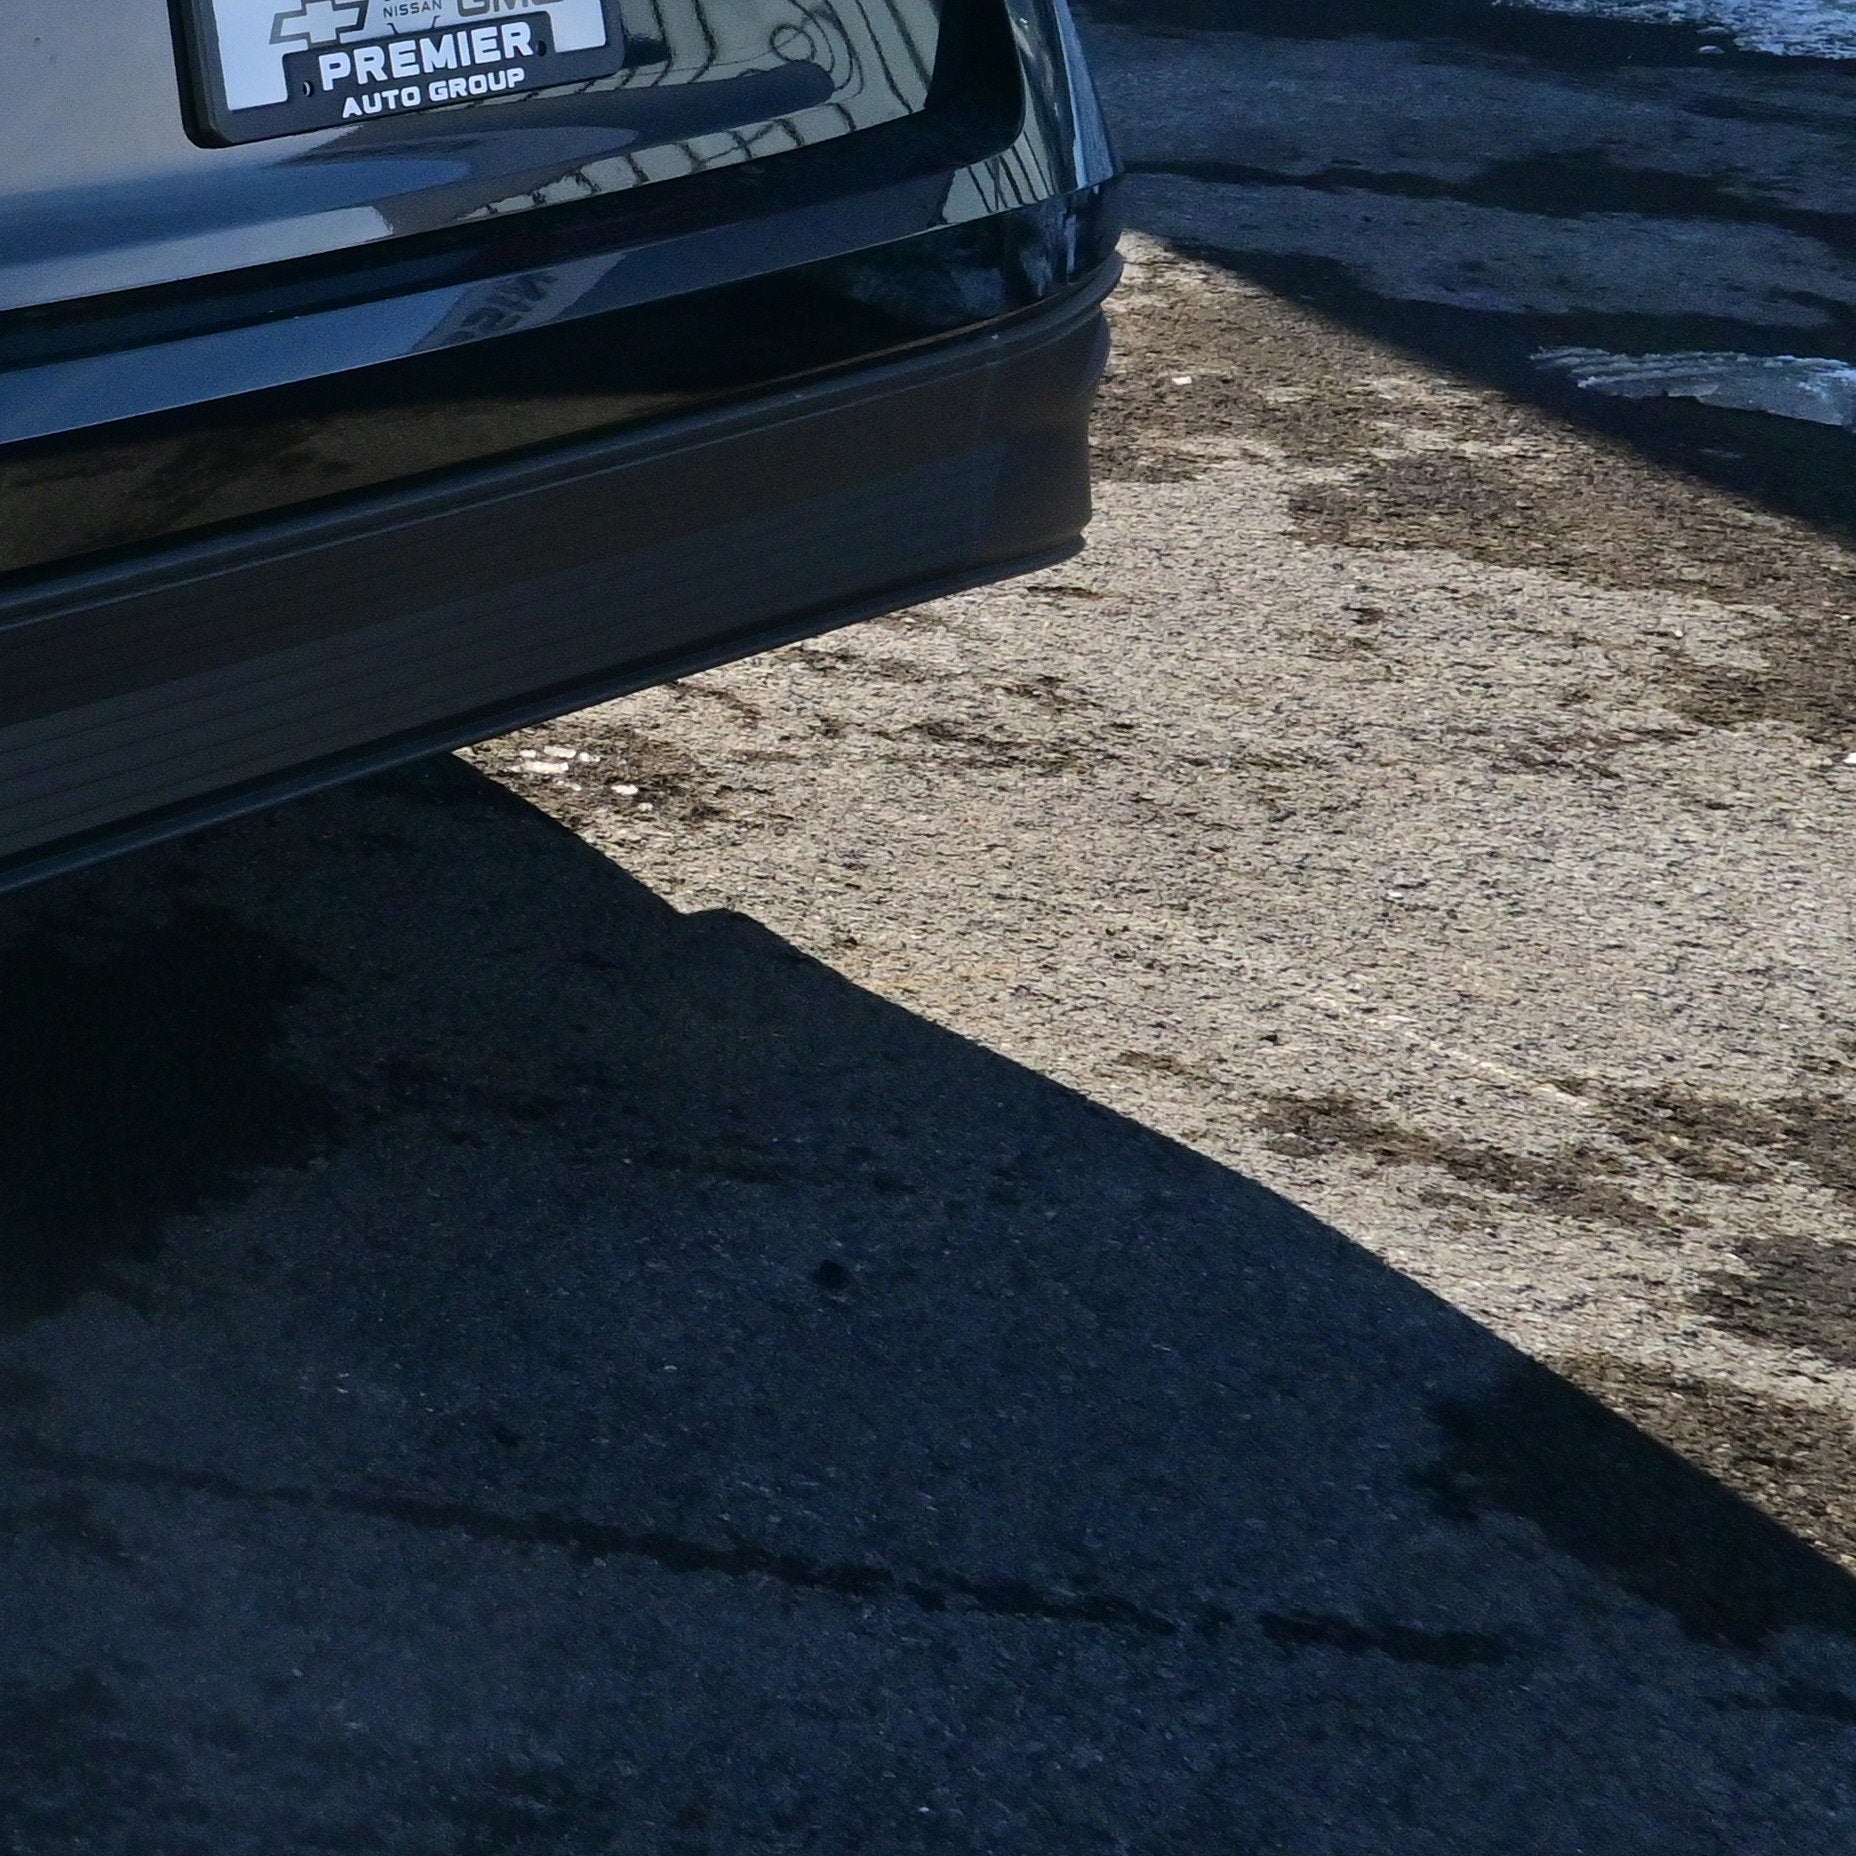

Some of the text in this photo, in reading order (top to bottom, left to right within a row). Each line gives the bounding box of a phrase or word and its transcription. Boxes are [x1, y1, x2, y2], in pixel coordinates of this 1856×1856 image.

[318, 20, 534, 91] PREMIER
[342, 67, 525, 119] AUTO GROUP
